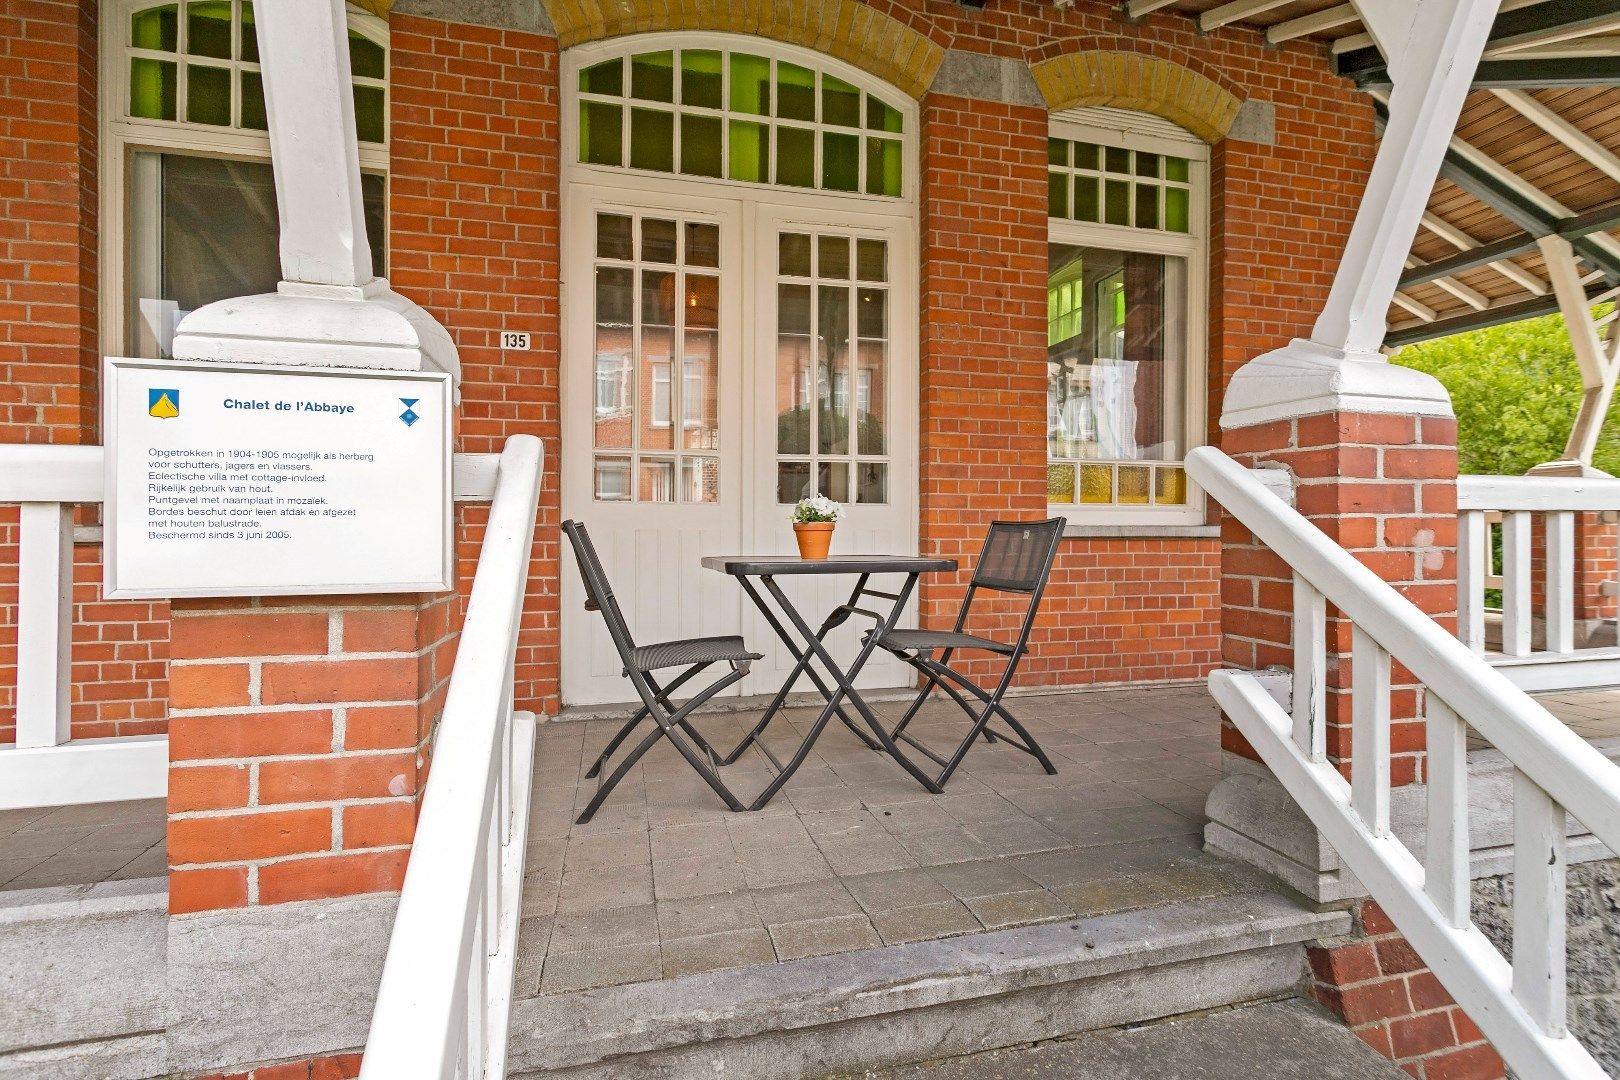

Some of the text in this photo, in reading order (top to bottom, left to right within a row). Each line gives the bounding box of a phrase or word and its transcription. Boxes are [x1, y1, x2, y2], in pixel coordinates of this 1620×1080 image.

[505, 334, 526, 348] 135
[223, 399, 270, 410] Chalet
[274, 401, 292, 411] de
[148, 448, 374, 462] Opgetrokken in 1904-1905 mogelijk als herberg
[173, 461, 223, 470] schutters,
[225, 462, 255, 471] jagers
[272, 462, 313, 471] vlassers.
[148, 472, 327, 483] Eclectische villa met cottage-invloed.
[148, 484, 186, 494] Rijkelijk
[189, 484, 226, 494] gebruik
[249, 485, 273, 493] hout.
[148, 496, 198, 505] Puntgevel
[222, 496, 273, 505] naamplaat
[276, 496, 284, 504] in
[287, 497, 328, 505] mozaïek.
[148, 508, 184, 516] Bordes
[187, 508, 227, 516] beschut
[229, 508, 253, 516] door
[255, 508, 277, 516] leien
[280, 508, 306, 516] afdak
[322, 508, 356, 517] afgezet
[148, 520, 262, 528] met houten balustrade.
[148, 531, 292, 540] Beschermd sinds 3 juni 2005.
